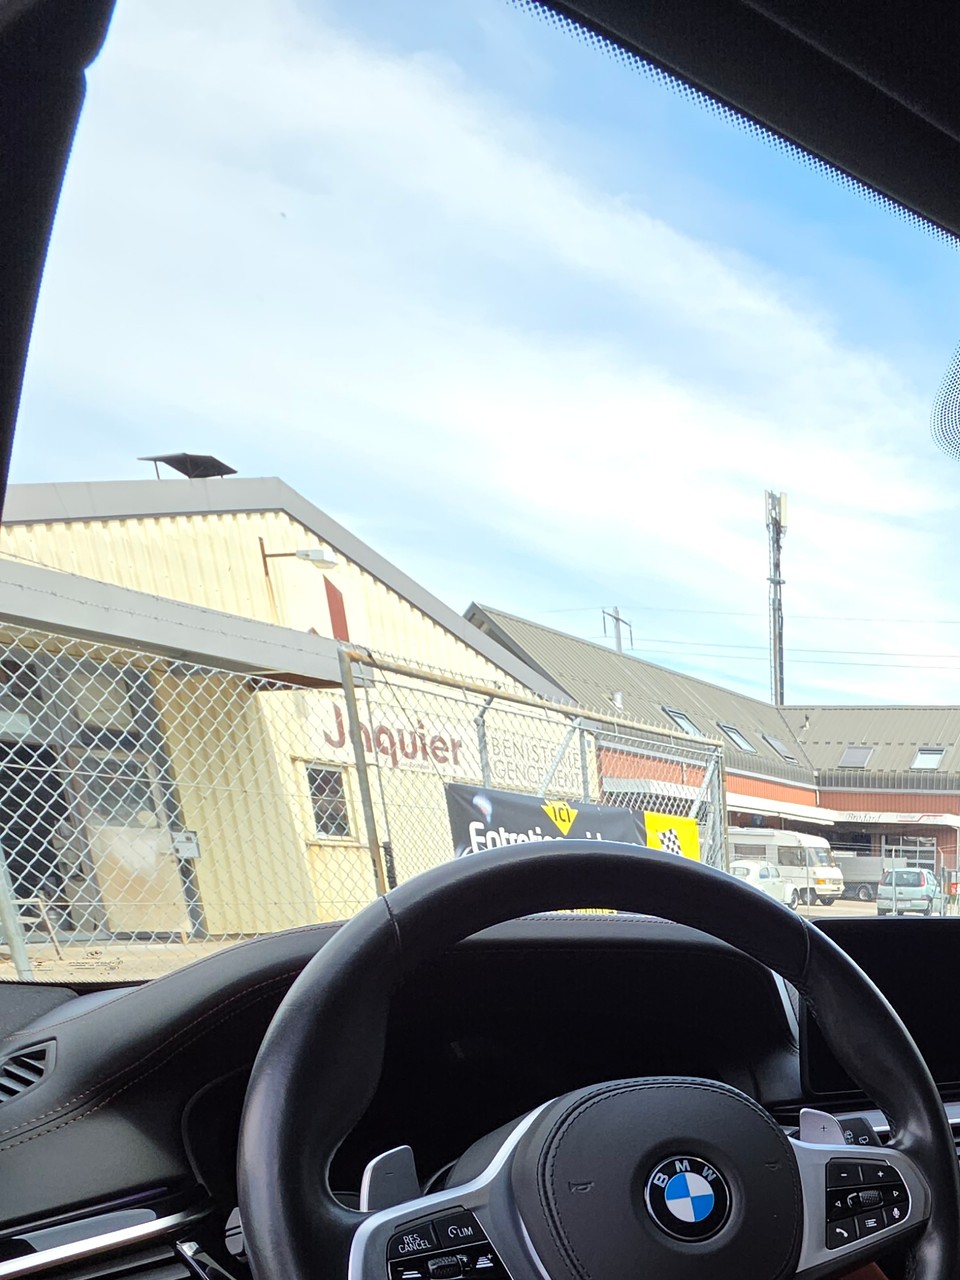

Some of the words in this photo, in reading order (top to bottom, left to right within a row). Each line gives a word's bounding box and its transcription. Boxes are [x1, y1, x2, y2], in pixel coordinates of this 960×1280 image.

[653, 1159, 717, 1188] BMW
[457, 1226, 474, 1238] LIM
[403, 1233, 421, 1245] RES
[398, 1240, 432, 1254] CANCEL
